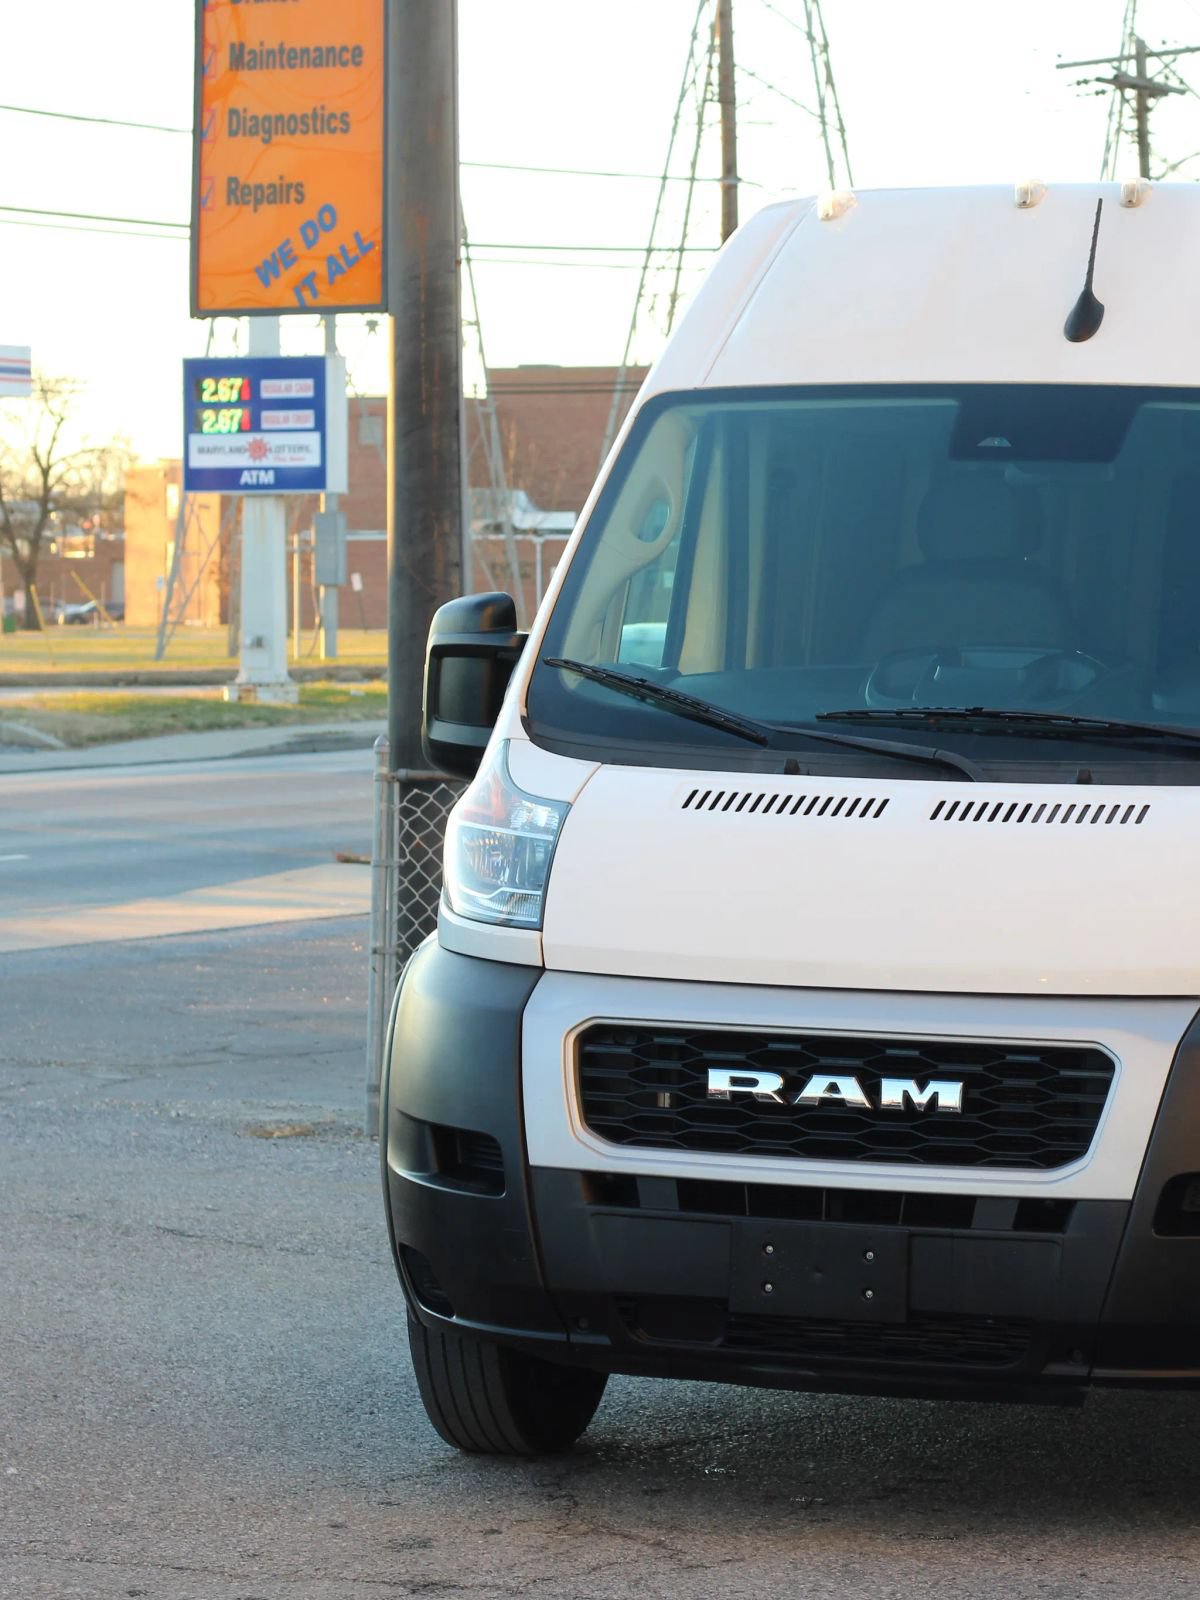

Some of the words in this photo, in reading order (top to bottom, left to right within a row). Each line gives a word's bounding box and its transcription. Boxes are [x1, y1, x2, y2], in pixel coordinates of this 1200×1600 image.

[229, 41, 364, 72] Maintenance
[227, 105, 350, 144] Diagnostics
[226, 175, 305, 213] Repairs
[254, 239, 299, 288] WE
[299, 203, 338, 250] DO
[293, 271, 320, 308] IT
[324, 231, 375, 284] ALL
[240, 469, 275, 485] ATM
[706, 1067, 965, 1114] RAM
